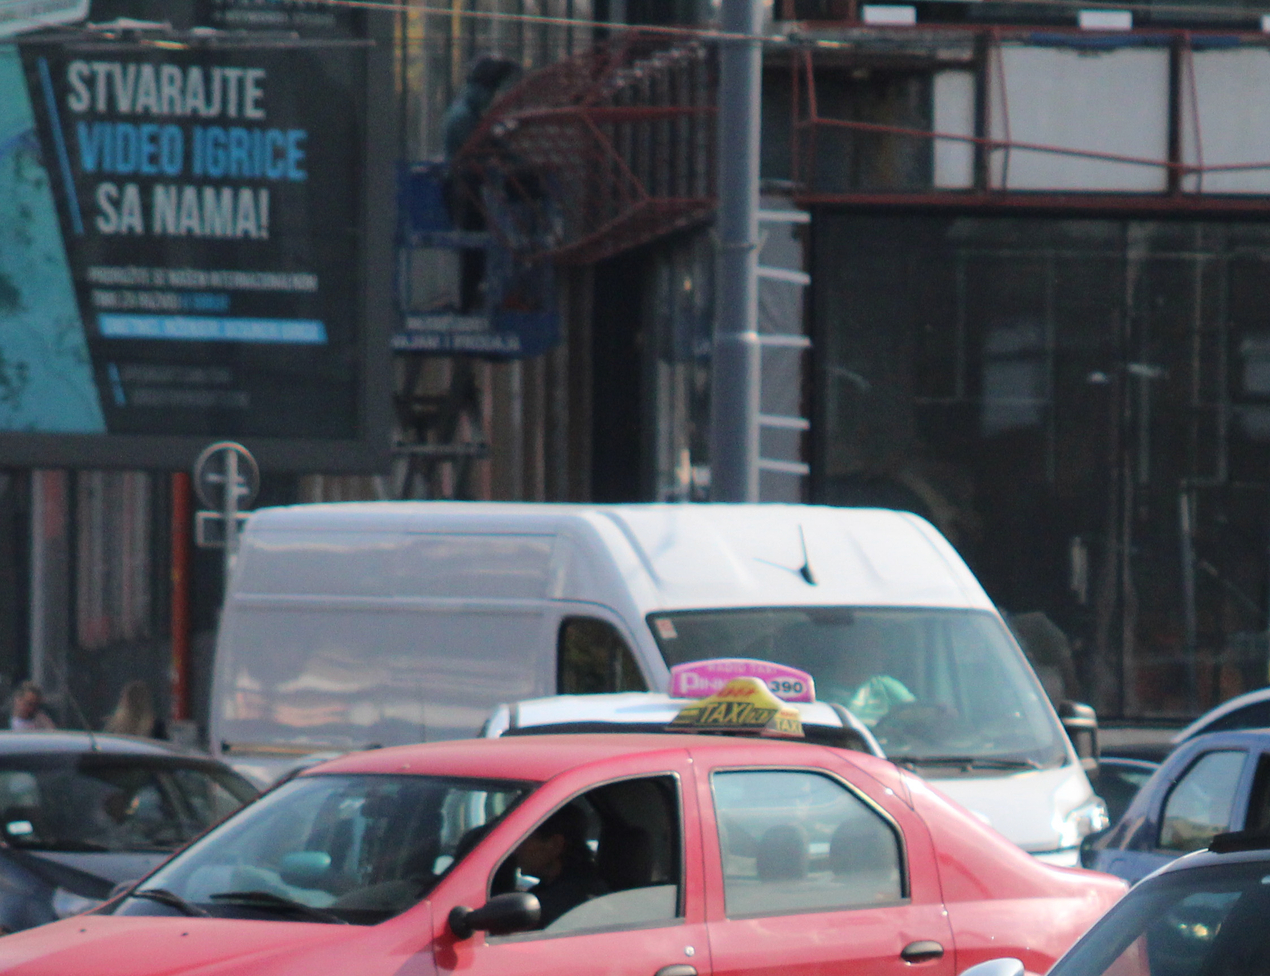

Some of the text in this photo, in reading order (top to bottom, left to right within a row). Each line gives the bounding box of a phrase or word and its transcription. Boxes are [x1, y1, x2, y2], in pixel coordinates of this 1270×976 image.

[66, 59, 267, 120] STVARAJTE
[77, 121, 308, 182] VIDEO IGRICE
[96, 182, 270, 240] SA NAMA!
[701, 702, 755, 723] TAXI
[769, 681, 803, 694] 390
